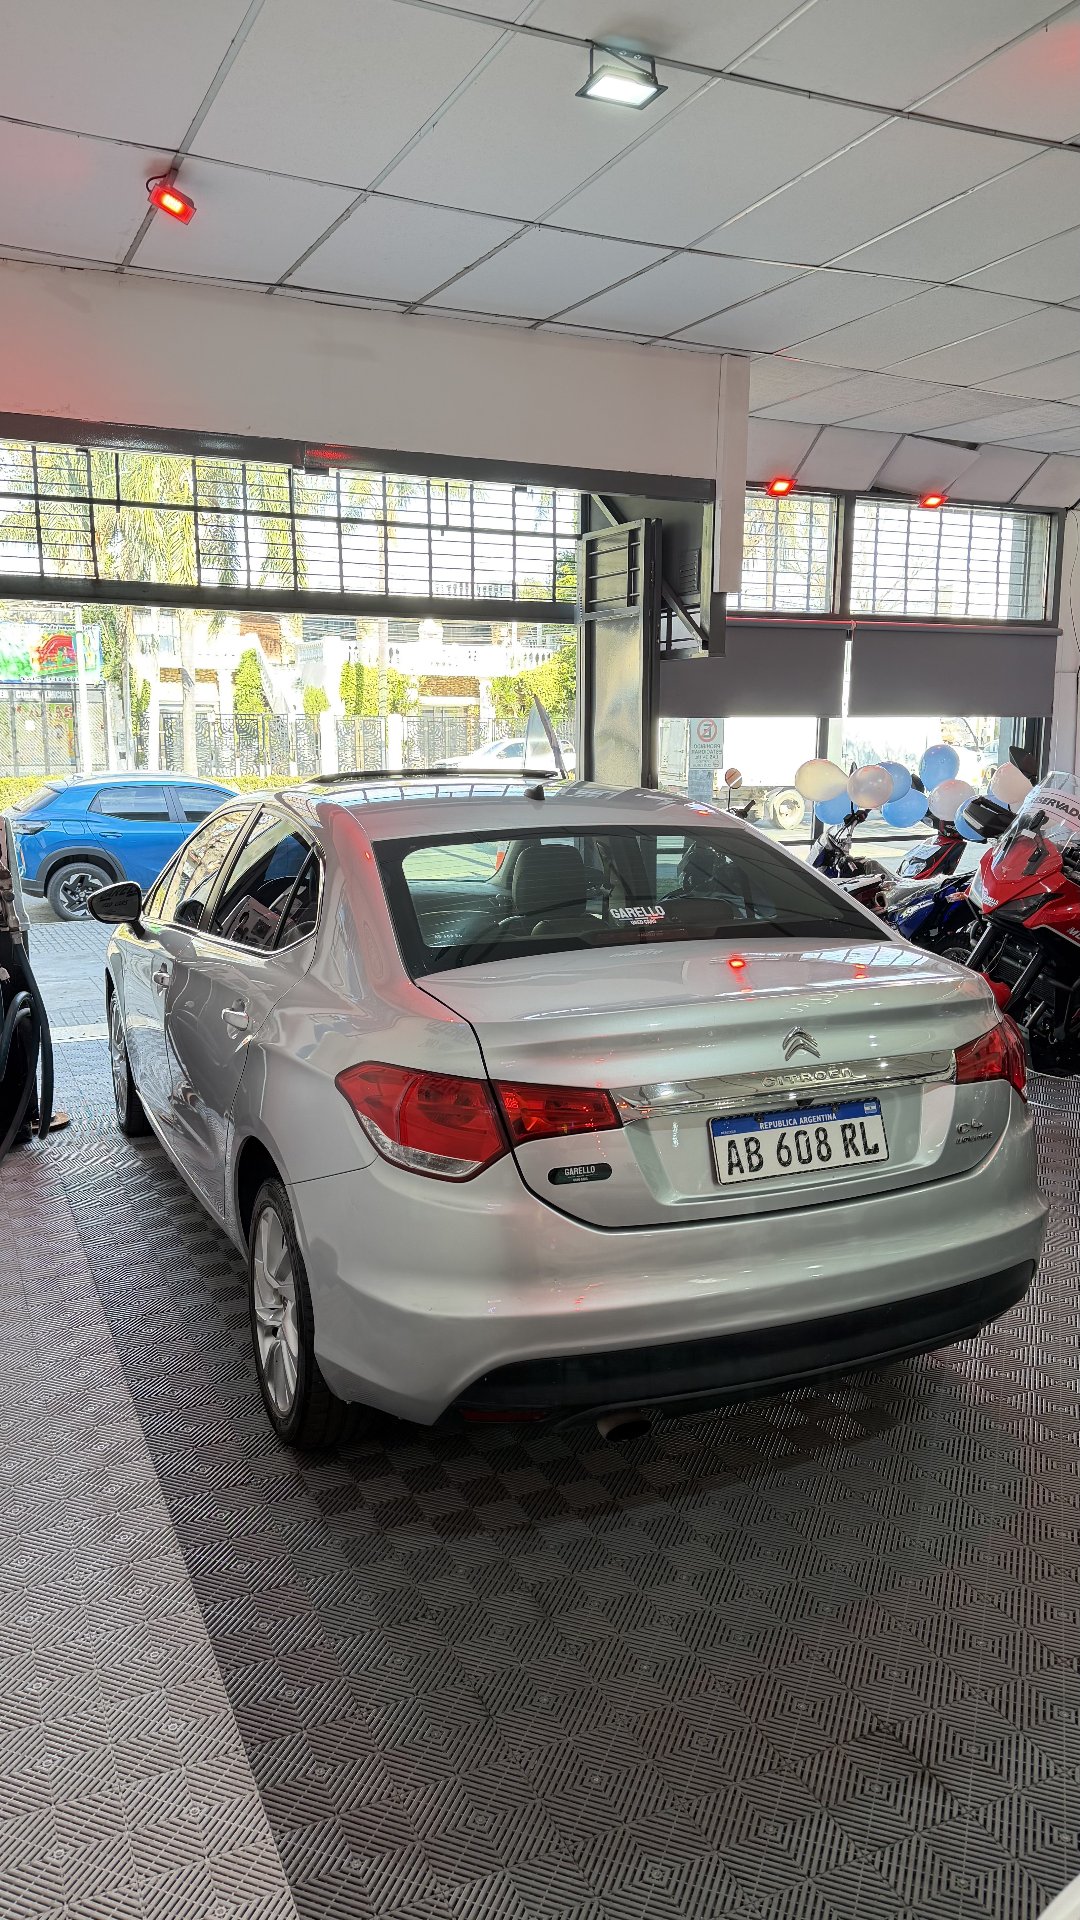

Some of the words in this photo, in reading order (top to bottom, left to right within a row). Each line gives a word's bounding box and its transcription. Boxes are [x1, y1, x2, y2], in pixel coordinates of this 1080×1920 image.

[609, 905, 666, 919] GARELLO
[759, 1118, 798, 1130] REPUBLICA
[799, 1113, 837, 1125] ARGENTINA
[956, 1118, 984, 1135] C4
[727, 1136, 764, 1176] AB
[776, 1126, 833, 1168] 608
[840, 1121, 880, 1159] RL
[564, 1165, 596, 1176] GARELLO
